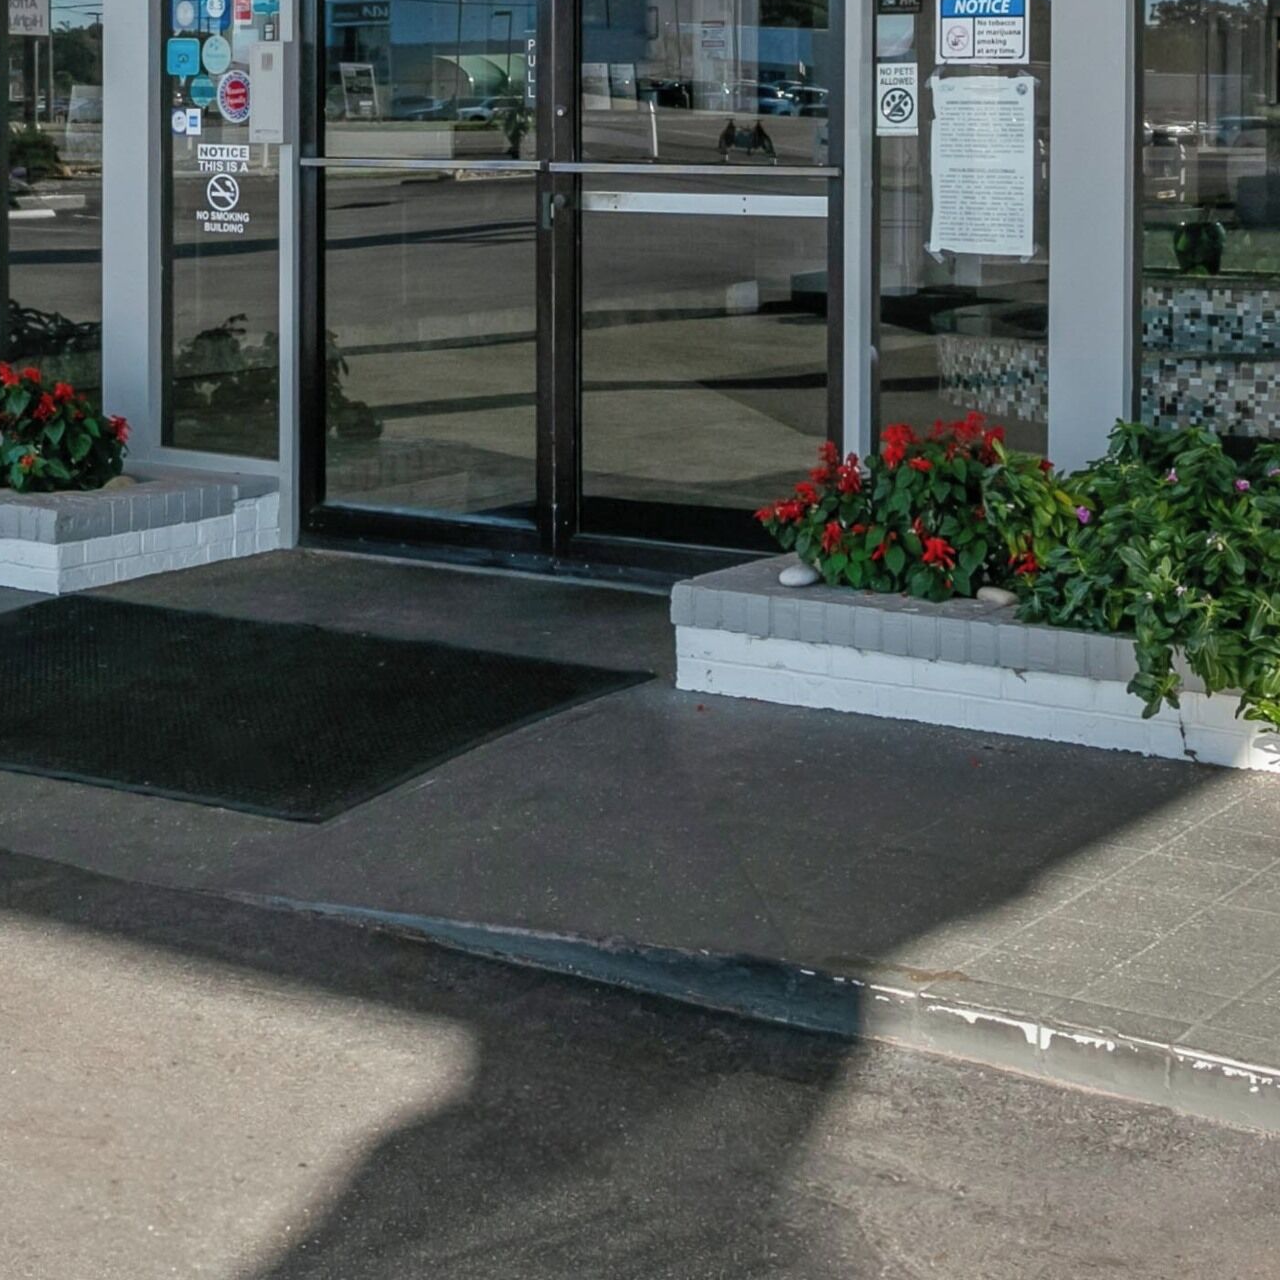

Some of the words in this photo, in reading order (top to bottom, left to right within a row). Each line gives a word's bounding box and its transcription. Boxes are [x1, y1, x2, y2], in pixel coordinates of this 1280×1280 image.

[528, 39, 536, 98] PULL
[880, 67, 891, 76] NO
[894, 66, 914, 76] PETS
[880, 77, 914, 86] ALLOWED
[200, 146, 248, 158] NOTICE
[198, 160, 223, 172] THIS
[227, 161, 237, 173] IS
[240, 162, 249, 173] A
[196, 210, 209, 221] NO
[210, 211, 250, 223] SMOKING
[203, 222, 244, 234] BUILDING
